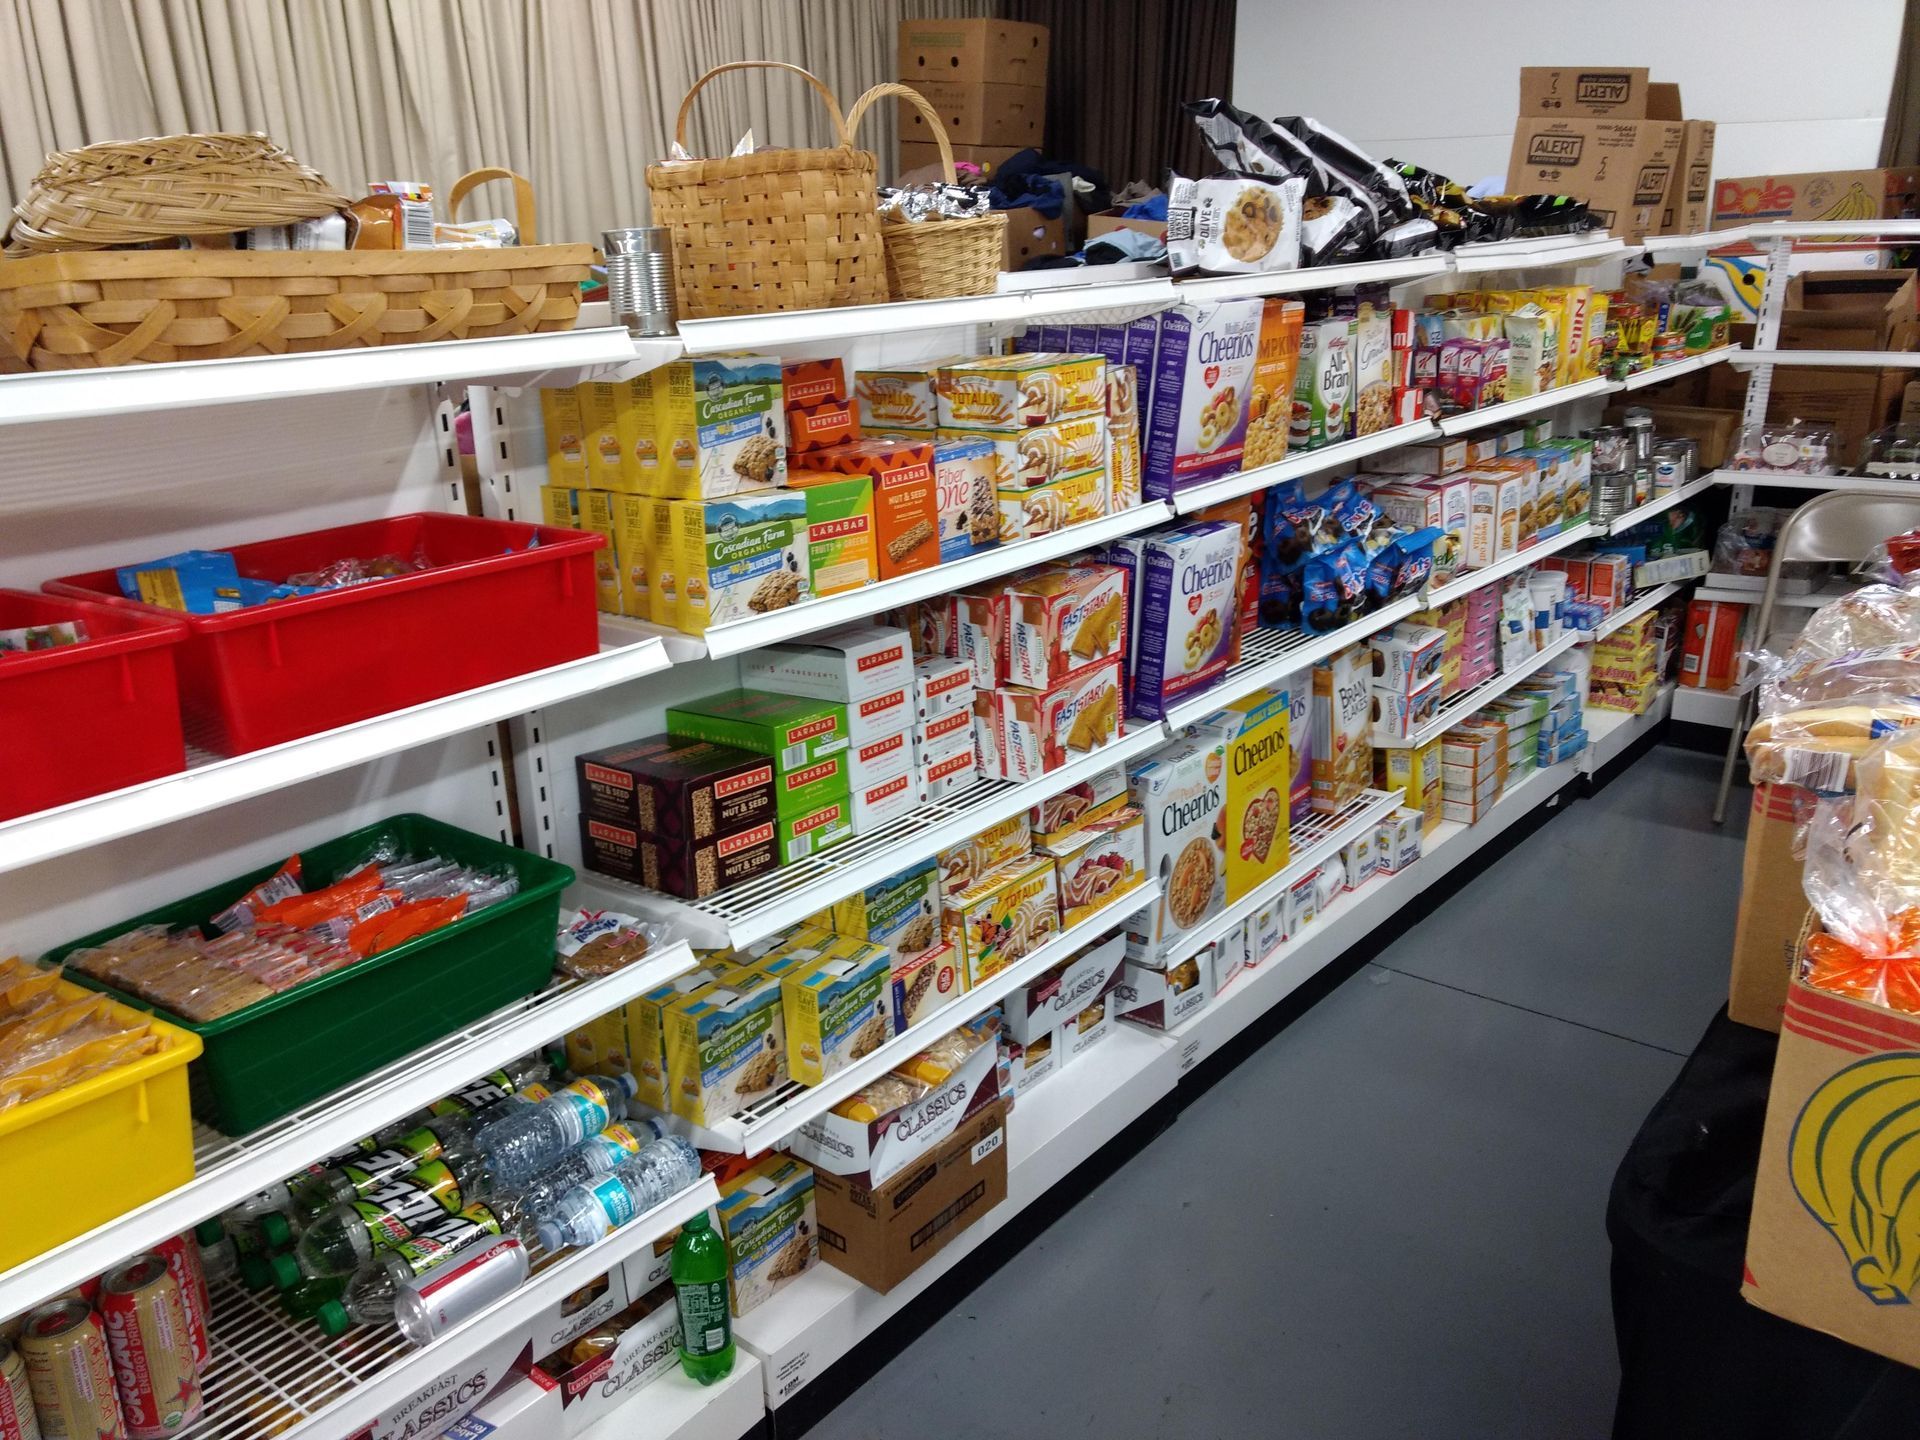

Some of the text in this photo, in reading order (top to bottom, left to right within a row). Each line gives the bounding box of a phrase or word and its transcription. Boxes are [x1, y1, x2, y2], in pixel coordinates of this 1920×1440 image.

[1580, 85, 1625, 98] ALERT
[1534, 139, 1578, 155] ALERT
[1716, 178, 1795, 214] Dole
[1168, 209, 1176, 238] SHOULD
[1175, 211, 1183, 237] TASTE
[1182, 211, 1191, 237] GOOD
[1200, 209, 1212, 239] OLIVE
[1163, 319, 1190, 333] Cheerios
[1198, 330, 1254, 364] Cheerios
[1260, 335, 1299, 358] MPKIN
[1330, 351, 1346, 372] All-
[669, 375, 692, 387] SAVE
[1060, 366, 1097, 385] TOTALLY
[1323, 370, 1349, 391] Bran
[791, 382, 832, 397] LARABAR
[951, 391, 1001, 406] TOTALLY
[703, 391, 765, 420] Cascadian Farm
[717, 406, 753, 420] ORGANIC
[811, 415, 849, 428] LARABAR
[1060, 421, 1097, 441] TOTALLY
[885, 468, 926, 485] LARABAR
[937, 468, 965, 486] Fiber
[1062, 477, 1097, 499] TOTALLY
[812, 520, 864, 537] LARABAR
[713, 527, 785, 561] Cascadian Farm
[731, 541, 771, 560] ORGANIC
[1147, 554, 1173, 569] Cheerios
[1181, 557, 1234, 595] Cheerios
[1062, 587, 1114, 631] FASTSTART
[859, 648, 901, 671] LARABAR
[1015, 621, 1034, 685] FASTSTART
[927, 671, 968, 695] LARABAR
[1338, 678, 1367, 710] BRAN
[861, 692, 902, 716] LARABAR
[1055, 679, 1108, 726] FASTSTART
[1342, 695, 1368, 723] FLAKES
[790, 718, 833, 740] LARABAR
[927, 714, 968, 738] LARABAR
[861, 737, 901, 761] LARABAR
[1010, 719, 1030, 780] FASTSTART
[1233, 728, 1285, 776] Cheerios
[588, 768, 629, 785] LARABAR
[790, 762, 834, 787] LARABAR
[929, 754, 970, 781] LARABAR
[591, 782, 630, 799] NUT & SEED
[719, 773, 768, 794] LARABAR
[867, 778, 906, 803] LARABAR
[722, 796, 768, 819] NUT & SEED
[796, 807, 837, 832] LARABAR
[1161, 785, 1220, 837] Cheerios
[592, 826, 632, 843] LARABAR
[722, 829, 769, 852] LARABAR
[982, 817, 1023, 848] TOTALLY
[725, 852, 771, 877] NUT & SEED
[1003, 875, 1048, 909] TOTALLY
[1053, 968, 1106, 1012] CLASSICS
[823, 983, 877, 1030] Cascadian Farm
[836, 1000, 866, 1025] ORGANIC
[1173, 992, 1204, 1016] CLASSICS
[704, 1016, 766, 1063] Cascadian Farm
[720, 1033, 754, 1059] ORGANIC
[1072, 1025, 1107, 1054] CLASSICS
[1018, 1060, 1054, 1090] CLASSICS
[896, 1082, 968, 1142] CLASSICS
[799, 1124, 855, 1159] CLASSICS
[976, 1135, 999, 1157] 020
[736, 1204, 799, 1257] Cascadian Farm
[751, 1221, 787, 1250] ORGANIC
[486, 1242, 512, 1260] Coke
[550, 1299, 615, 1346] CLASSICS
[124, 1311, 151, 1394] ENERGY DRINK
[623, 1325, 676, 1366] BREAKFAST
[103, 1310, 145, 1426] ORGANIC
[570, 1374, 592, 1394] Little
[591, 1359, 615, 1385] Debbie
[601, 1332, 684, 1399] CLASSIC
[383, 1369, 489, 1440] ASSICS
[392, 1374, 459, 1425] BREAKFAST
